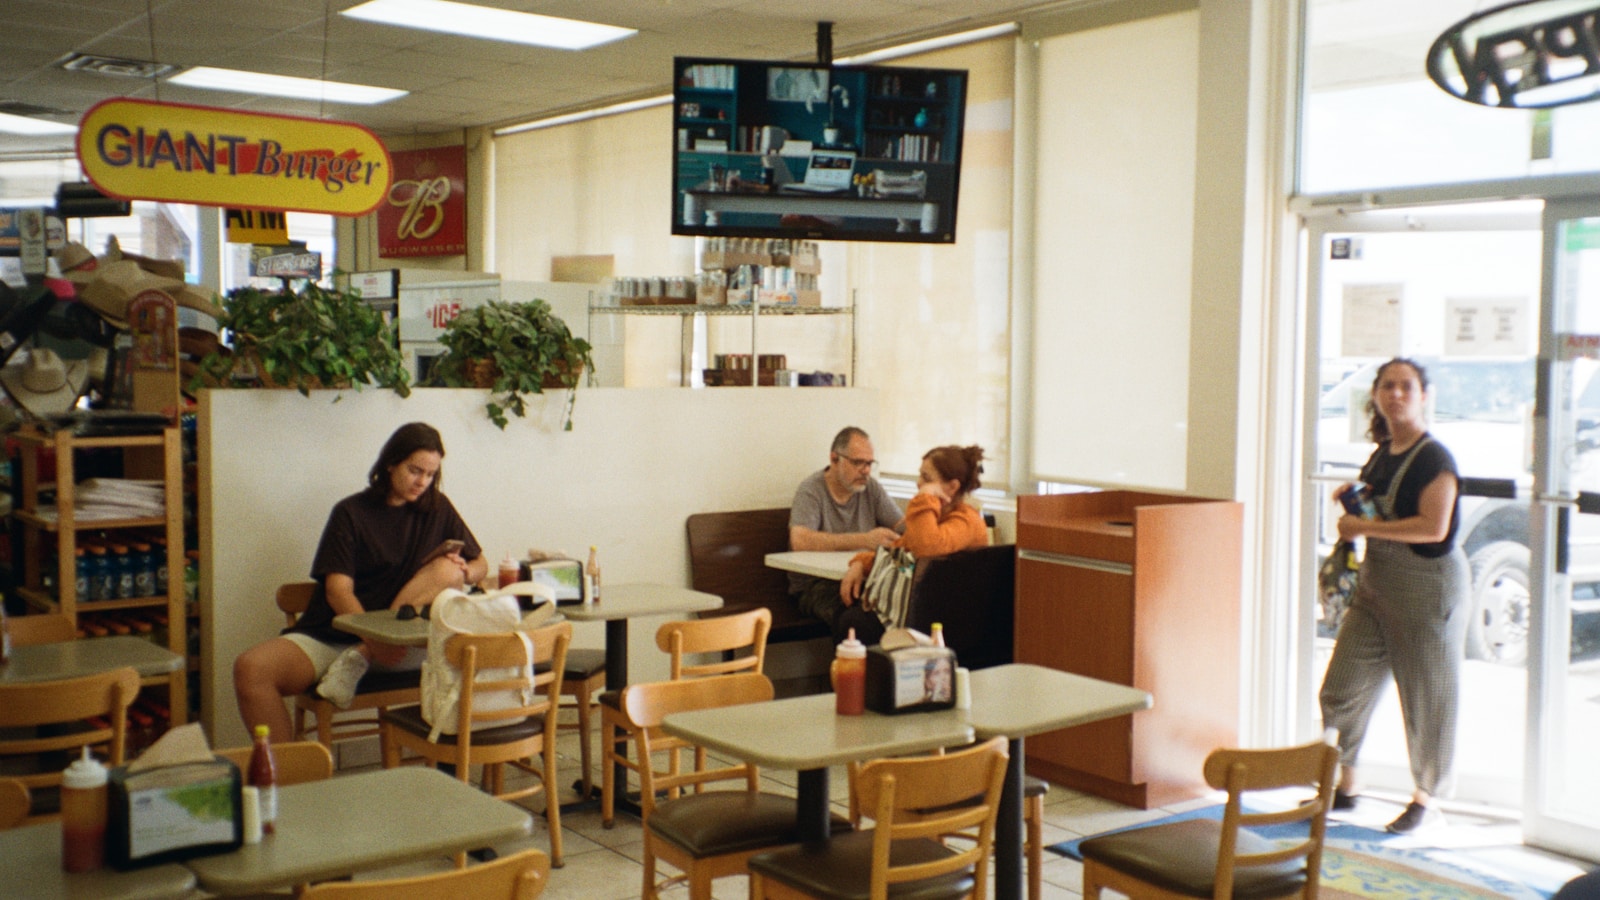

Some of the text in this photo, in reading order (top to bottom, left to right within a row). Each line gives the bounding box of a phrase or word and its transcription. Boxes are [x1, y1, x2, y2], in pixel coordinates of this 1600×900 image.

[96, 122, 381, 194] GIANT Burger
[379, 243, 465, 256] BUDWEISER
